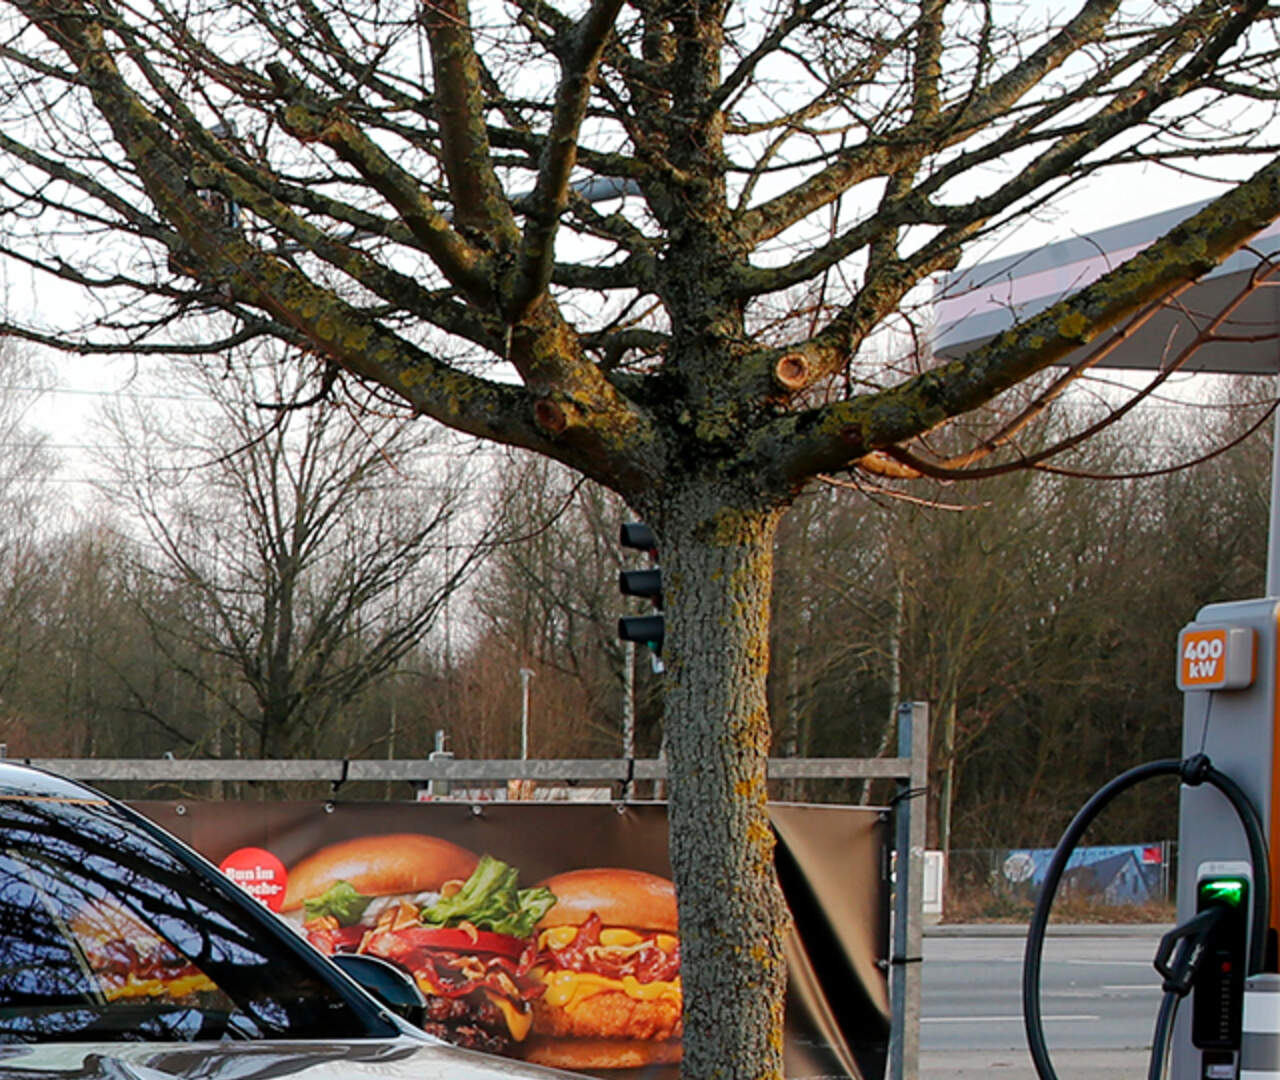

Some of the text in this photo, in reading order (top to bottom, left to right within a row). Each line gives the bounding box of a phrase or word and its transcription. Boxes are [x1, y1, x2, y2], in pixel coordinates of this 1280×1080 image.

[1184, 638, 1223, 660] 400
[1189, 660, 1217, 678] kW
[256, 866, 274, 880] im
